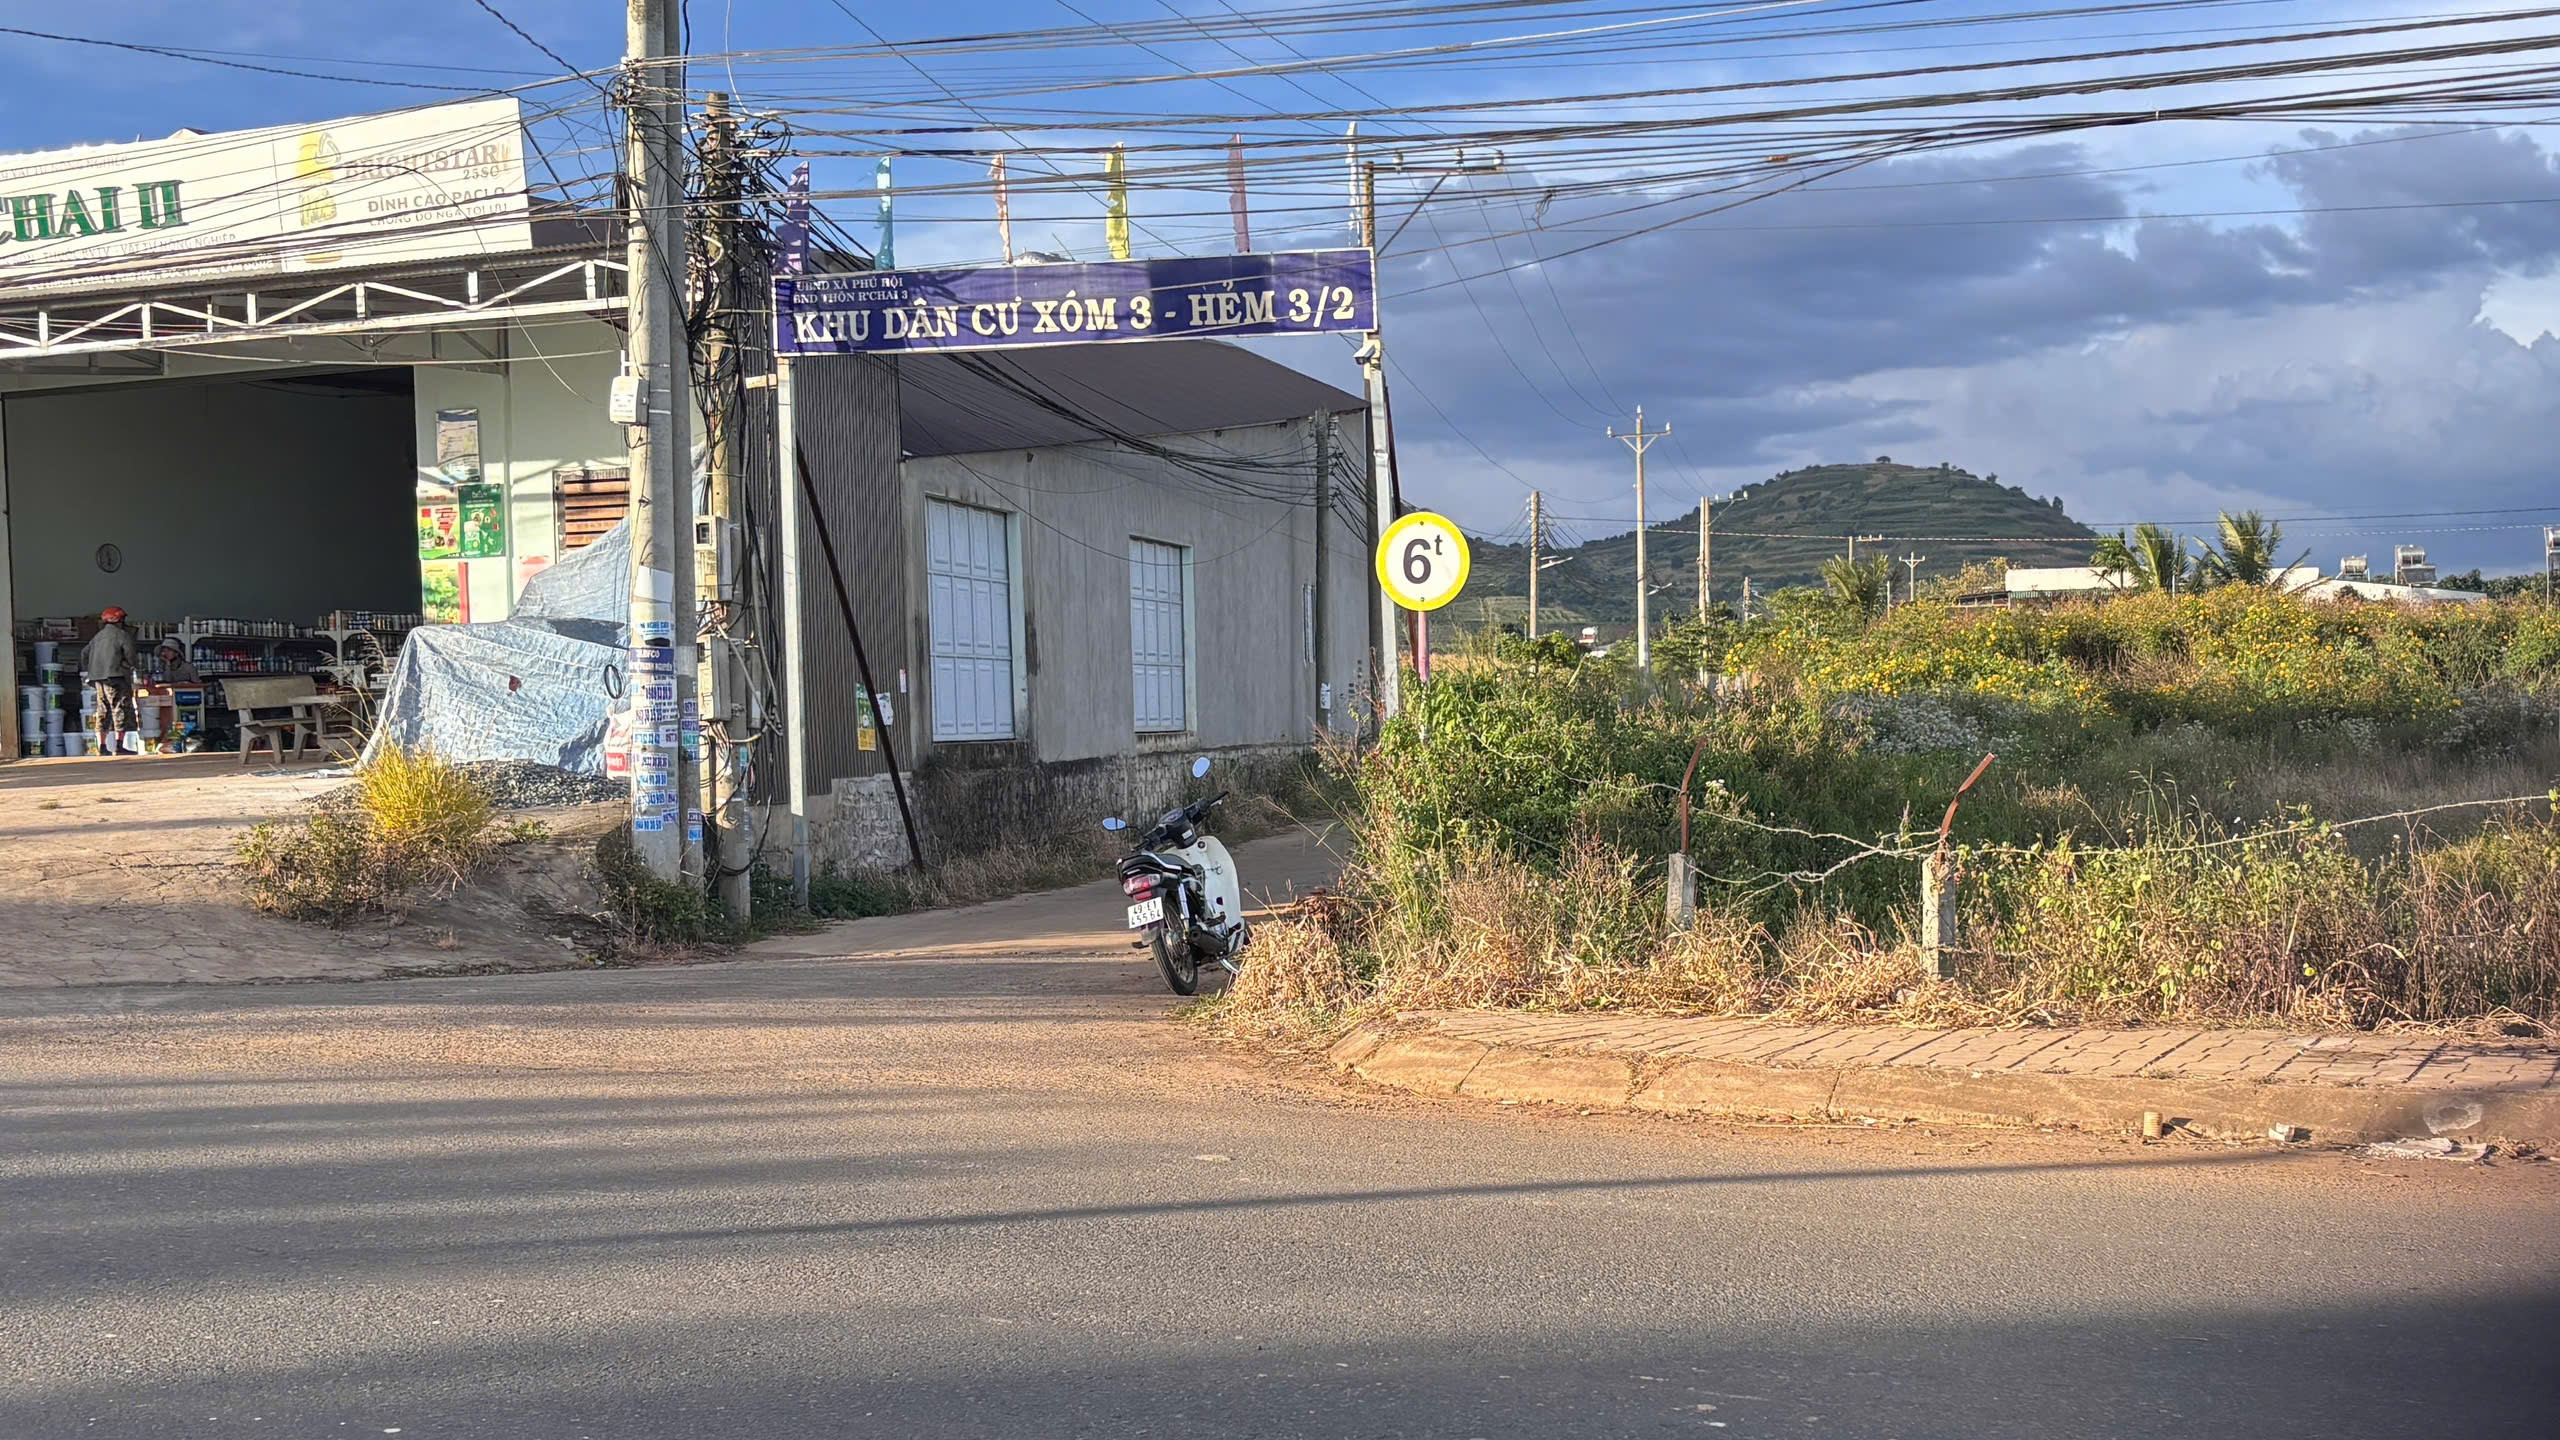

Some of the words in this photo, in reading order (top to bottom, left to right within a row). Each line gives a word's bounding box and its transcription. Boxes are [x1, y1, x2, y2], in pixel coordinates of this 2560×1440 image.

[413, 193, 447, 208] CAO
[796, 280, 830, 291] UBND
[852, 276, 878, 289] PHÚ
[793, 293, 818, 304] BND
[822, 291, 855, 303] THÔN
[901, 291, 908, 300] 3
[793, 309, 871, 343] KHU
[882, 298, 959, 339] DÂN
[971, 296, 1022, 336] CƯ
[1032, 289, 1119, 333] XÓM
[1130, 296, 1152, 330] 3
[1188, 280, 1276, 327] HẺM
[1288, 286, 1354, 328] 3/2
